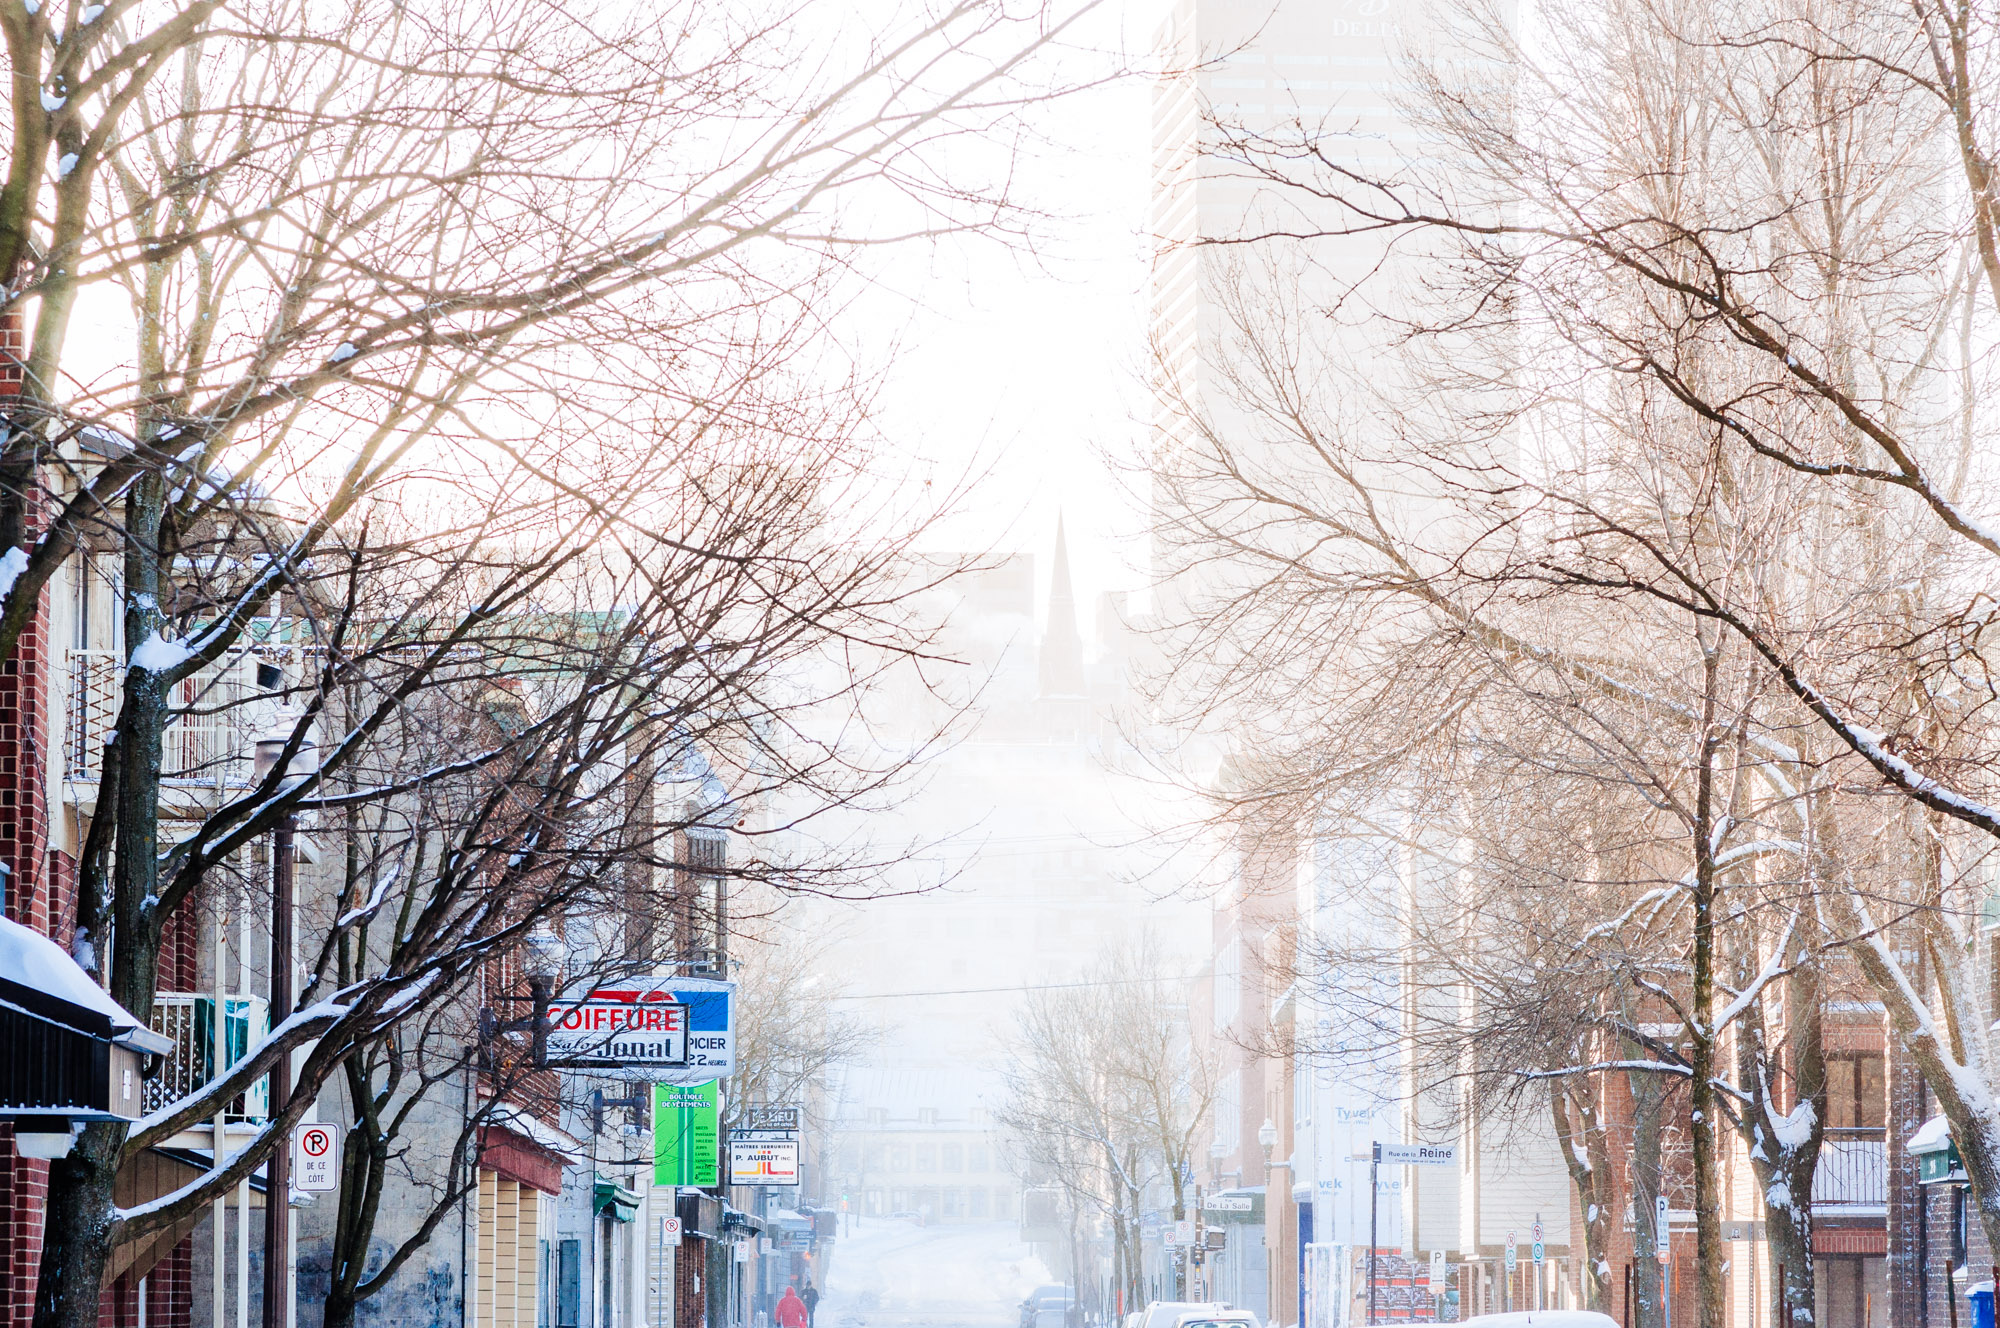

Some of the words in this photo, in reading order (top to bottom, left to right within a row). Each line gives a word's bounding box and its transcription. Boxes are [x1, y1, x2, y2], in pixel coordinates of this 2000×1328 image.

[546, 1007, 679, 1031] COIFFURE
[547, 1038, 594, 1054] Salo
[669, 1093, 703, 1101] BOUTIQUE
[1388, 1150, 1401, 1158] Rue
[1419, 1147, 1453, 1159] Reine
[307, 1161, 315, 1170] DE
[318, 1161, 326, 1169] CE
[1231, 1202, 1250, 1210] Salle
